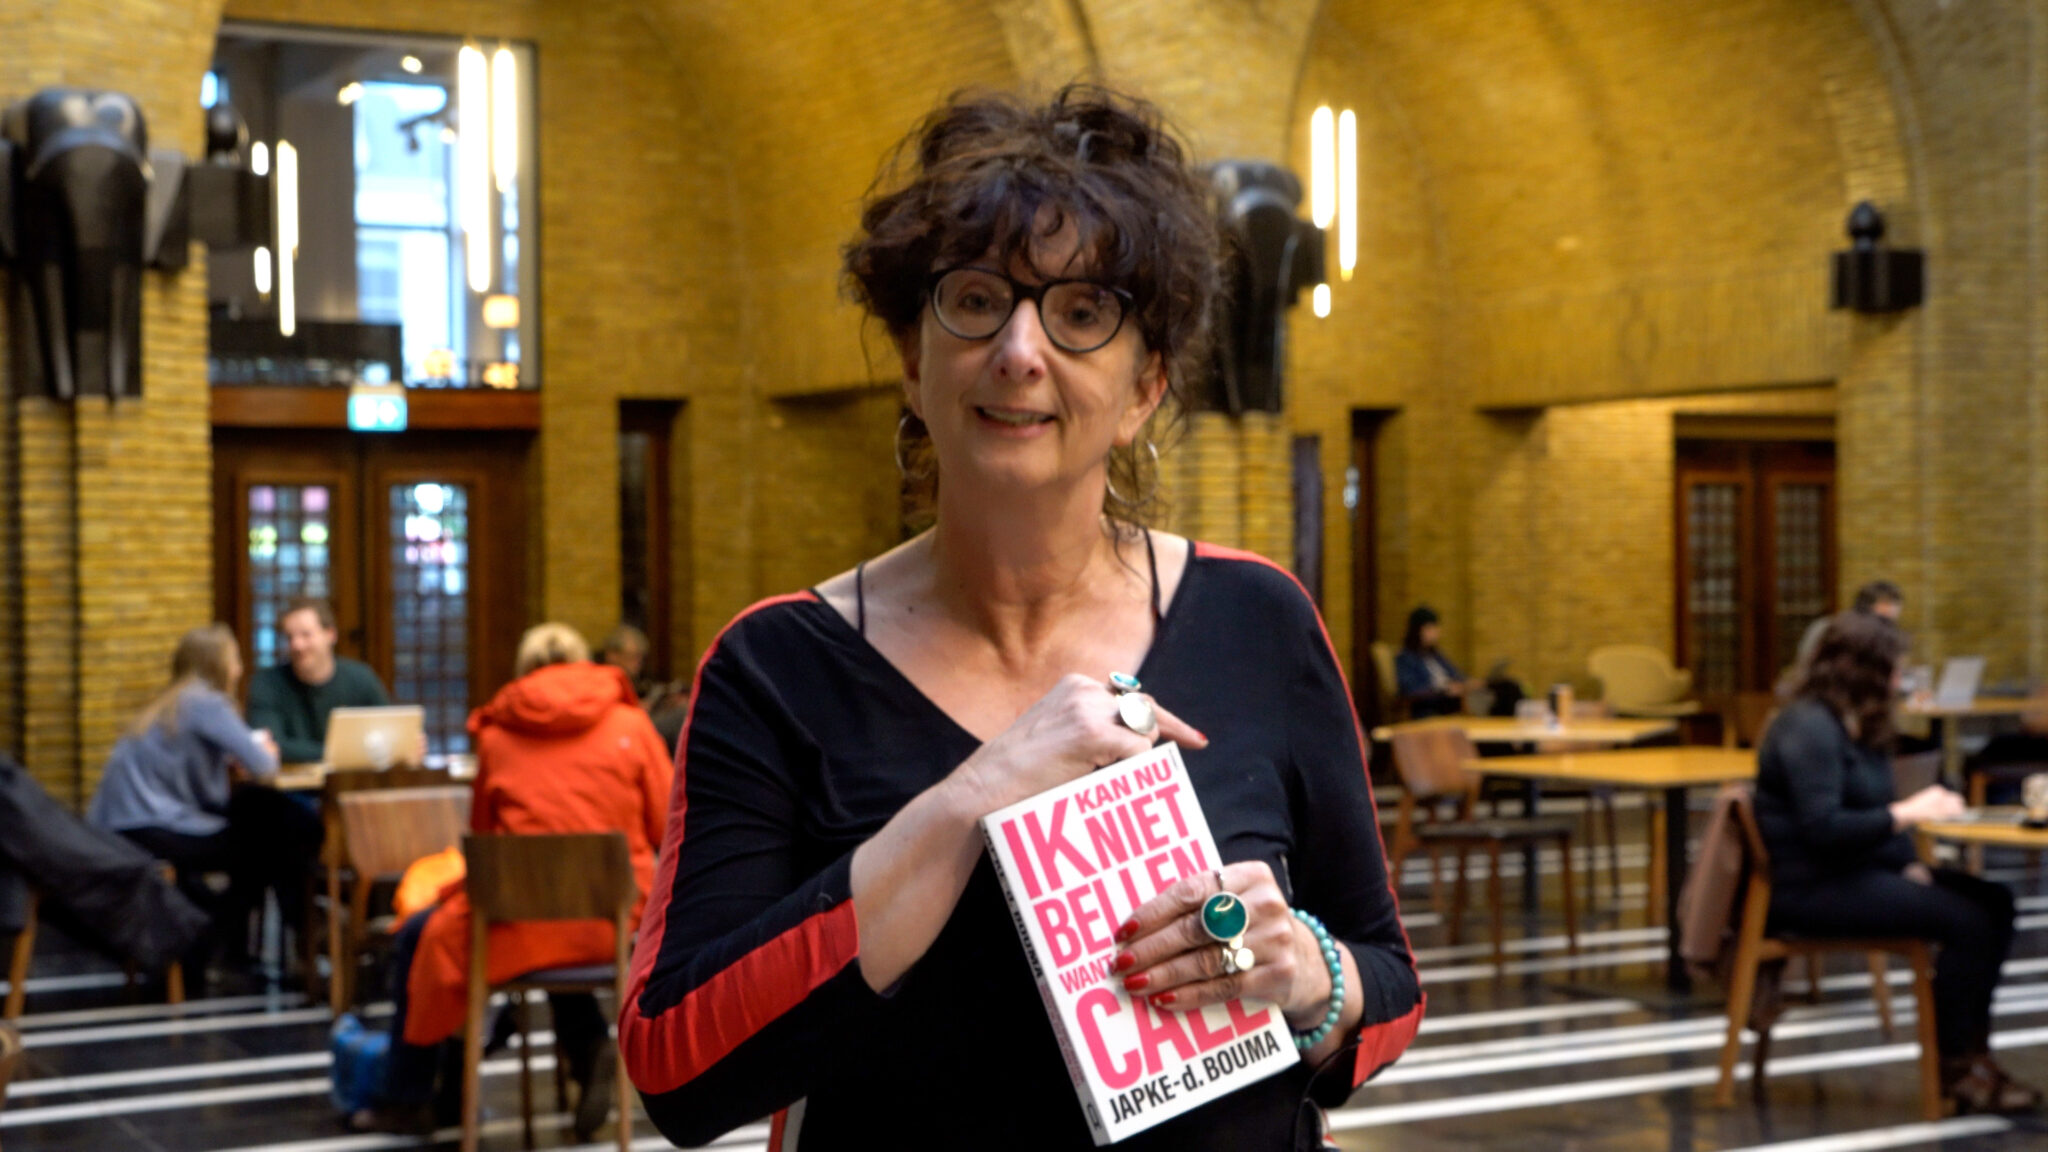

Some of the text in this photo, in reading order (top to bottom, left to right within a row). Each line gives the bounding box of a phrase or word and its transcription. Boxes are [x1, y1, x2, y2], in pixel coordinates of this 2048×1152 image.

[1001, 798, 1097, 900] IK
[1078, 774, 1132, 814] KAN
[1133, 758, 1172, 790] NU
[1084, 784, 1189, 870] NIET
[1110, 1031, 1280, 1123] JAPKE-d. BOUMA
